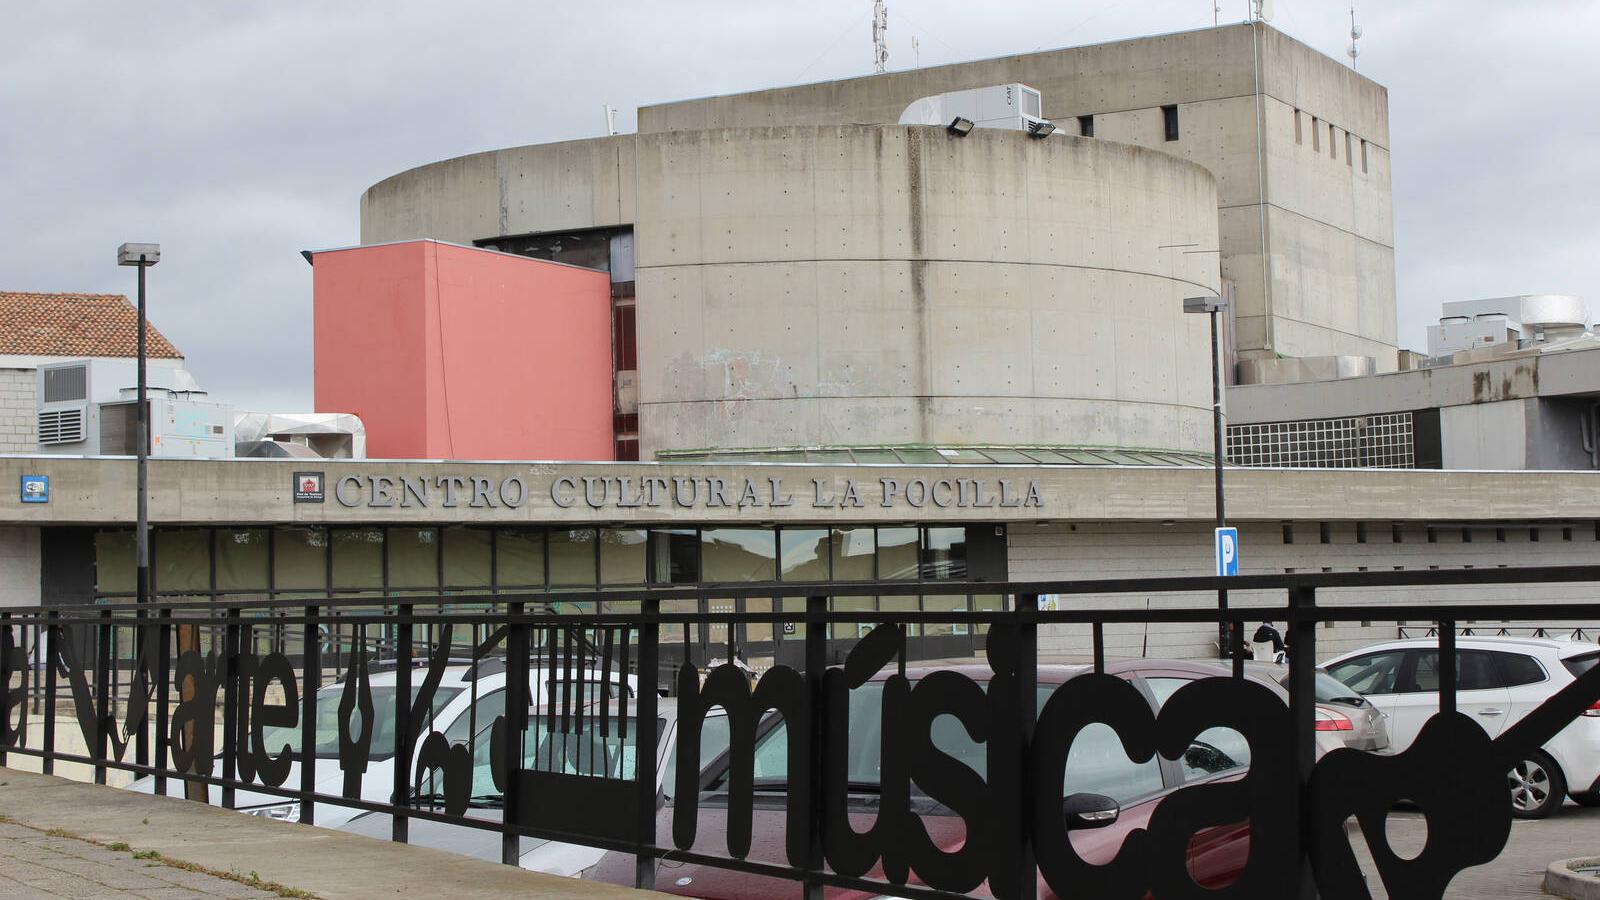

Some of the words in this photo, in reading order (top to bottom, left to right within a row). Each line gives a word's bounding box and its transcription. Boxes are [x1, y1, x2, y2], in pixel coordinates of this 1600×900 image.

[335, 474, 529, 508] CENTRO
[551, 475, 793, 508] CULTURAL
[811, 477, 865, 508] LA
[879, 477, 1044, 508] POCILLA
[1221, 534, 1235, 576] P
[171, 624, 299, 788] arte
[671, 622, 1297, 900] música
